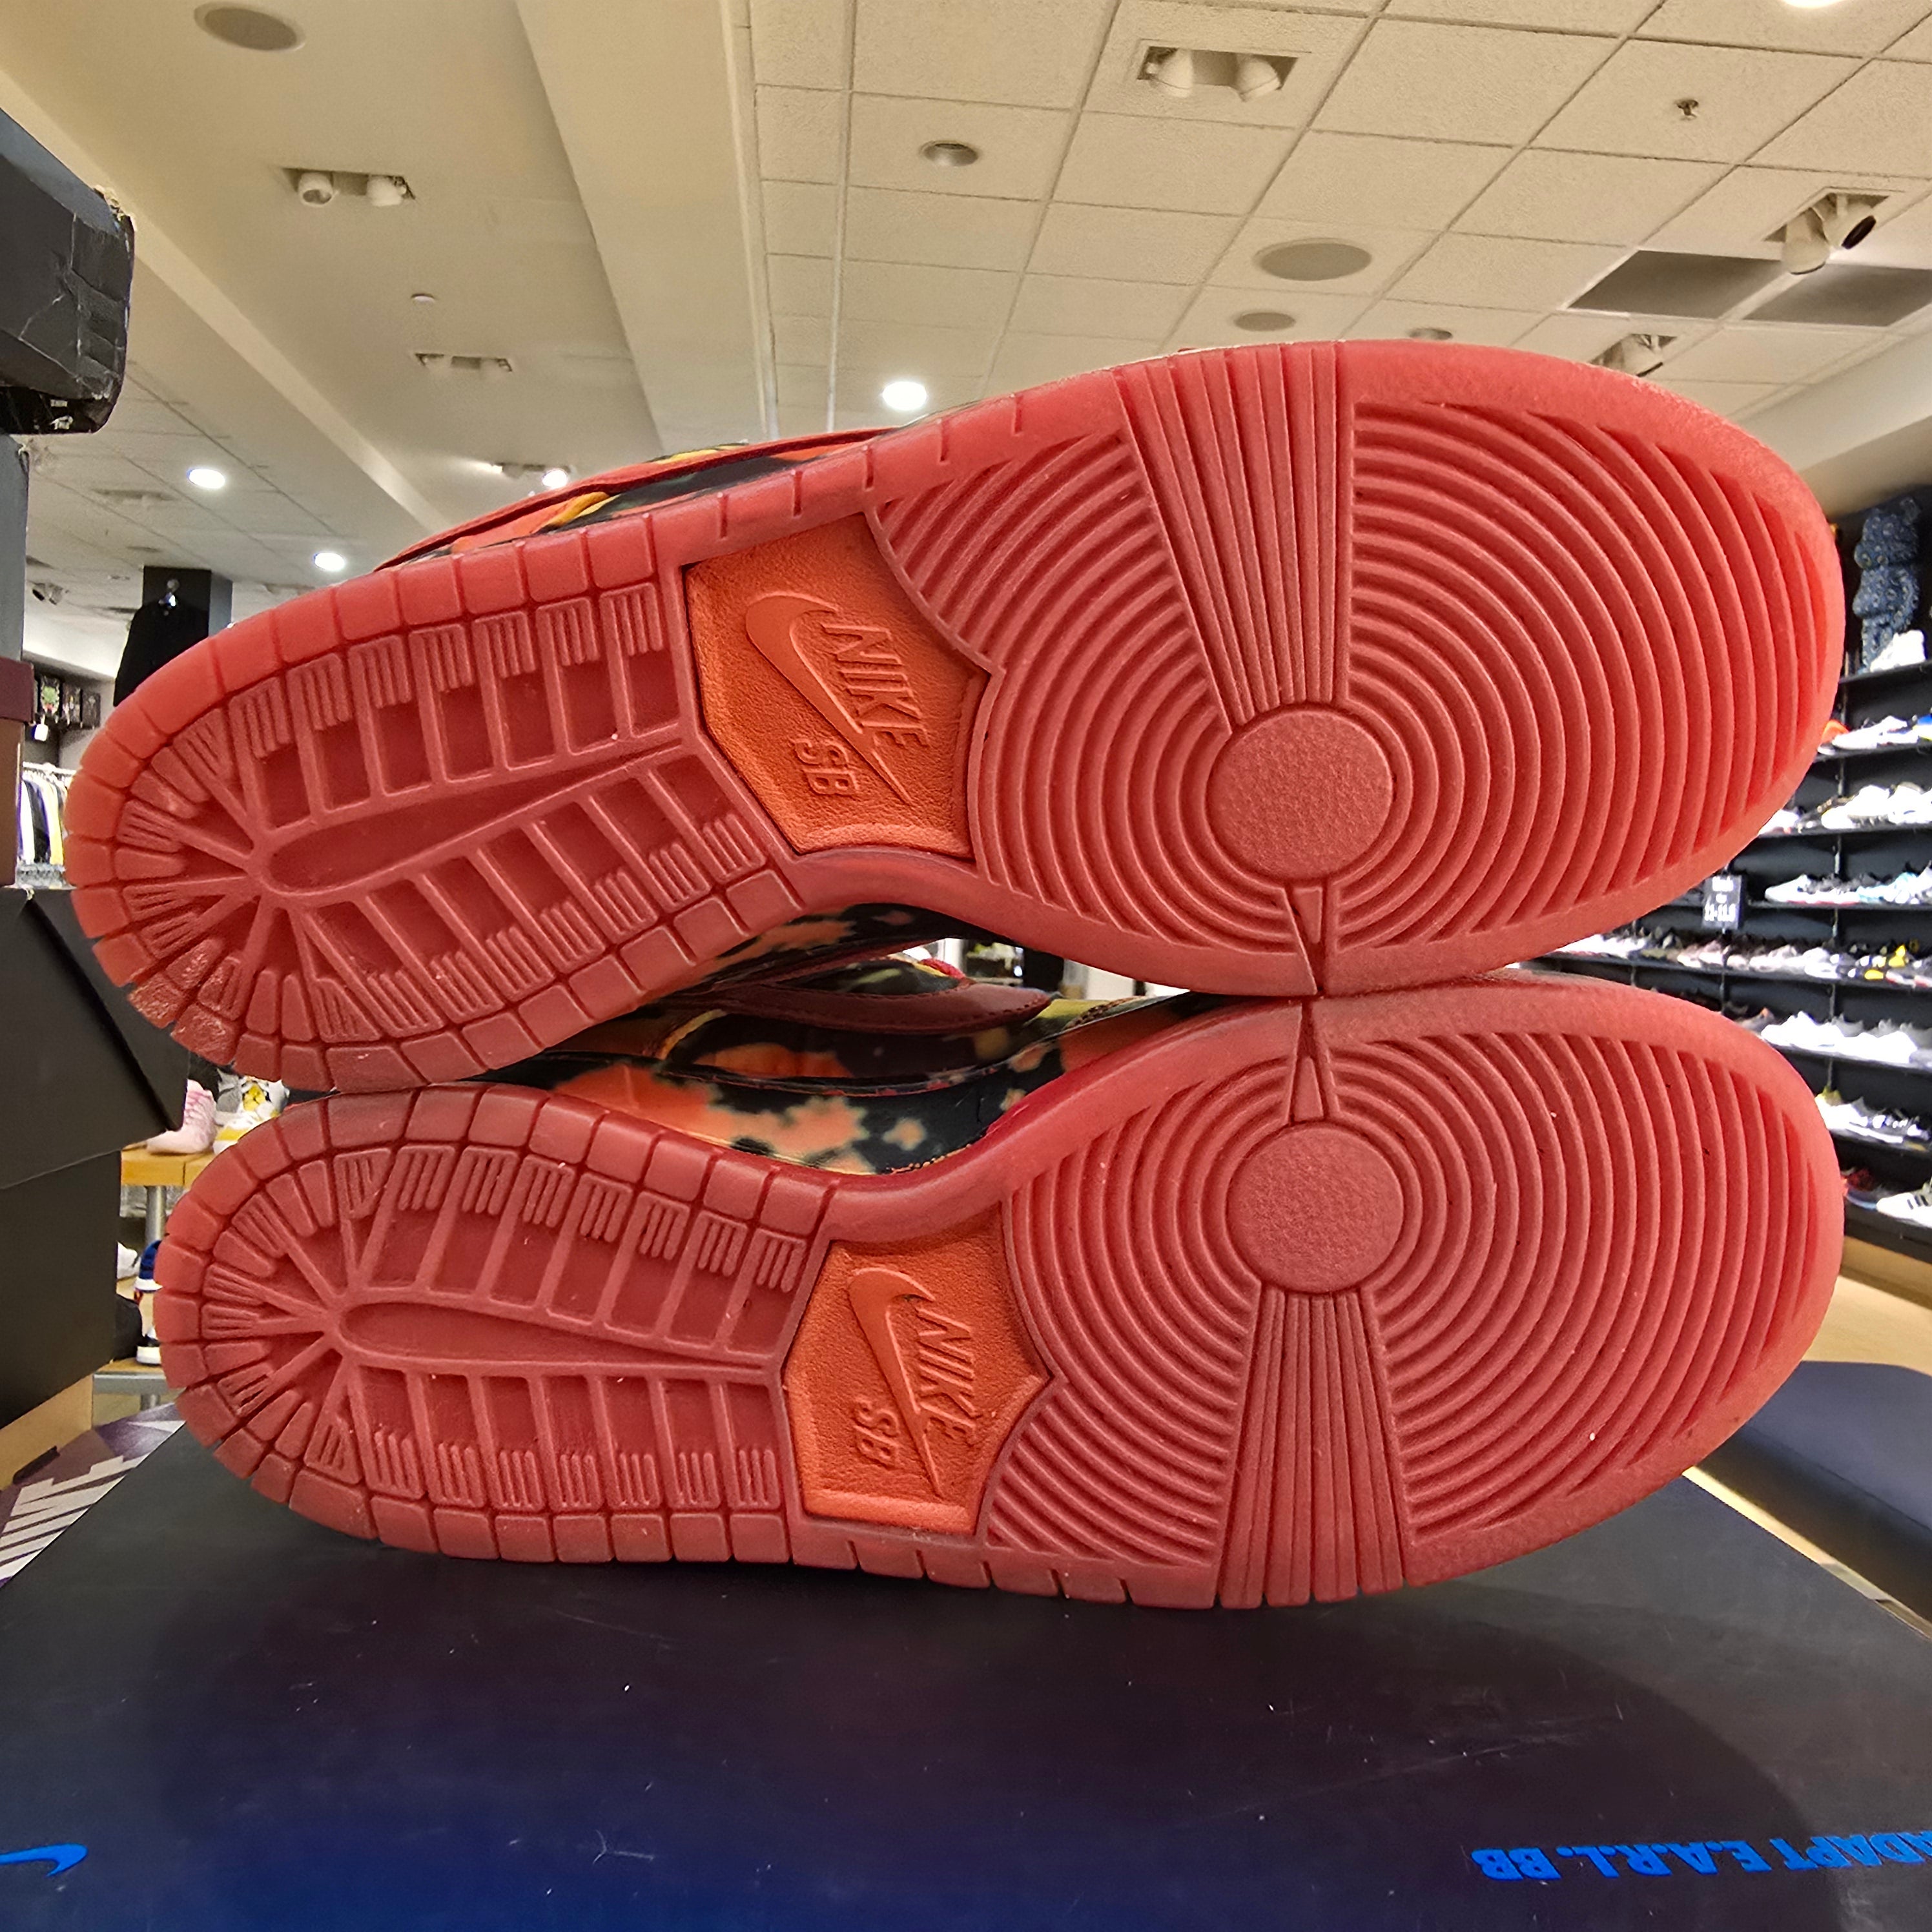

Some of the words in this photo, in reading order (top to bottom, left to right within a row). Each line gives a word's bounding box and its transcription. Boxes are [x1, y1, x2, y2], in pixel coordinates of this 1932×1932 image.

[821, 622, 931, 748] NIKE
[790, 737, 860, 801] SB
[914, 1306, 981, 1446] NIKE
[854, 1399, 901, 1469] SB
[1471, 1847, 1561, 1880] BB
